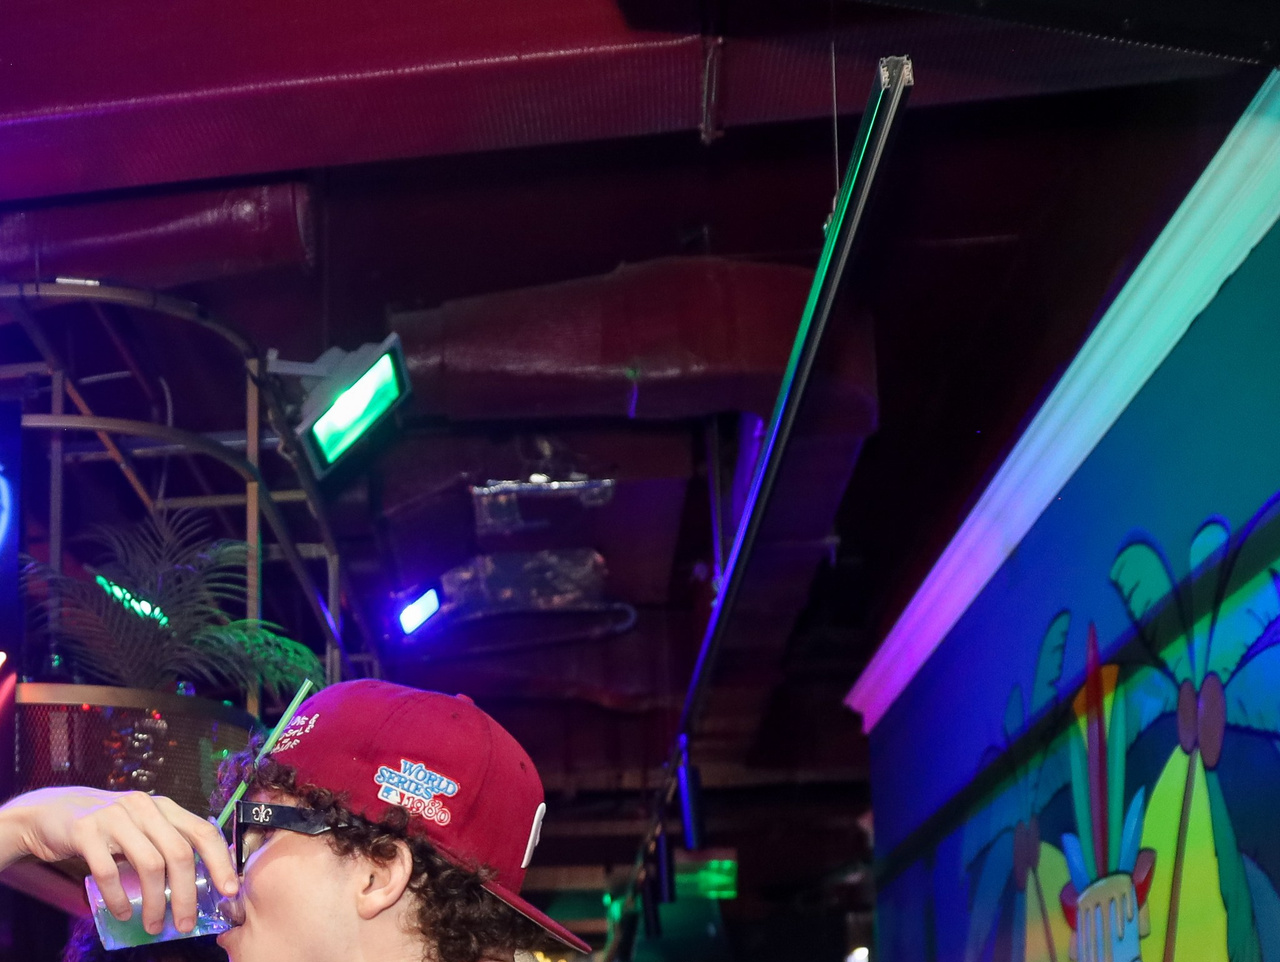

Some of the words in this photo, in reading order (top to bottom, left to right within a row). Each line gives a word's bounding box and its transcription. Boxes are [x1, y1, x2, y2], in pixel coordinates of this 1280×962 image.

[374, 766, 433, 800] SERIES
[401, 759, 458, 797] WORLD
[404, 796, 451, 826] 1980
